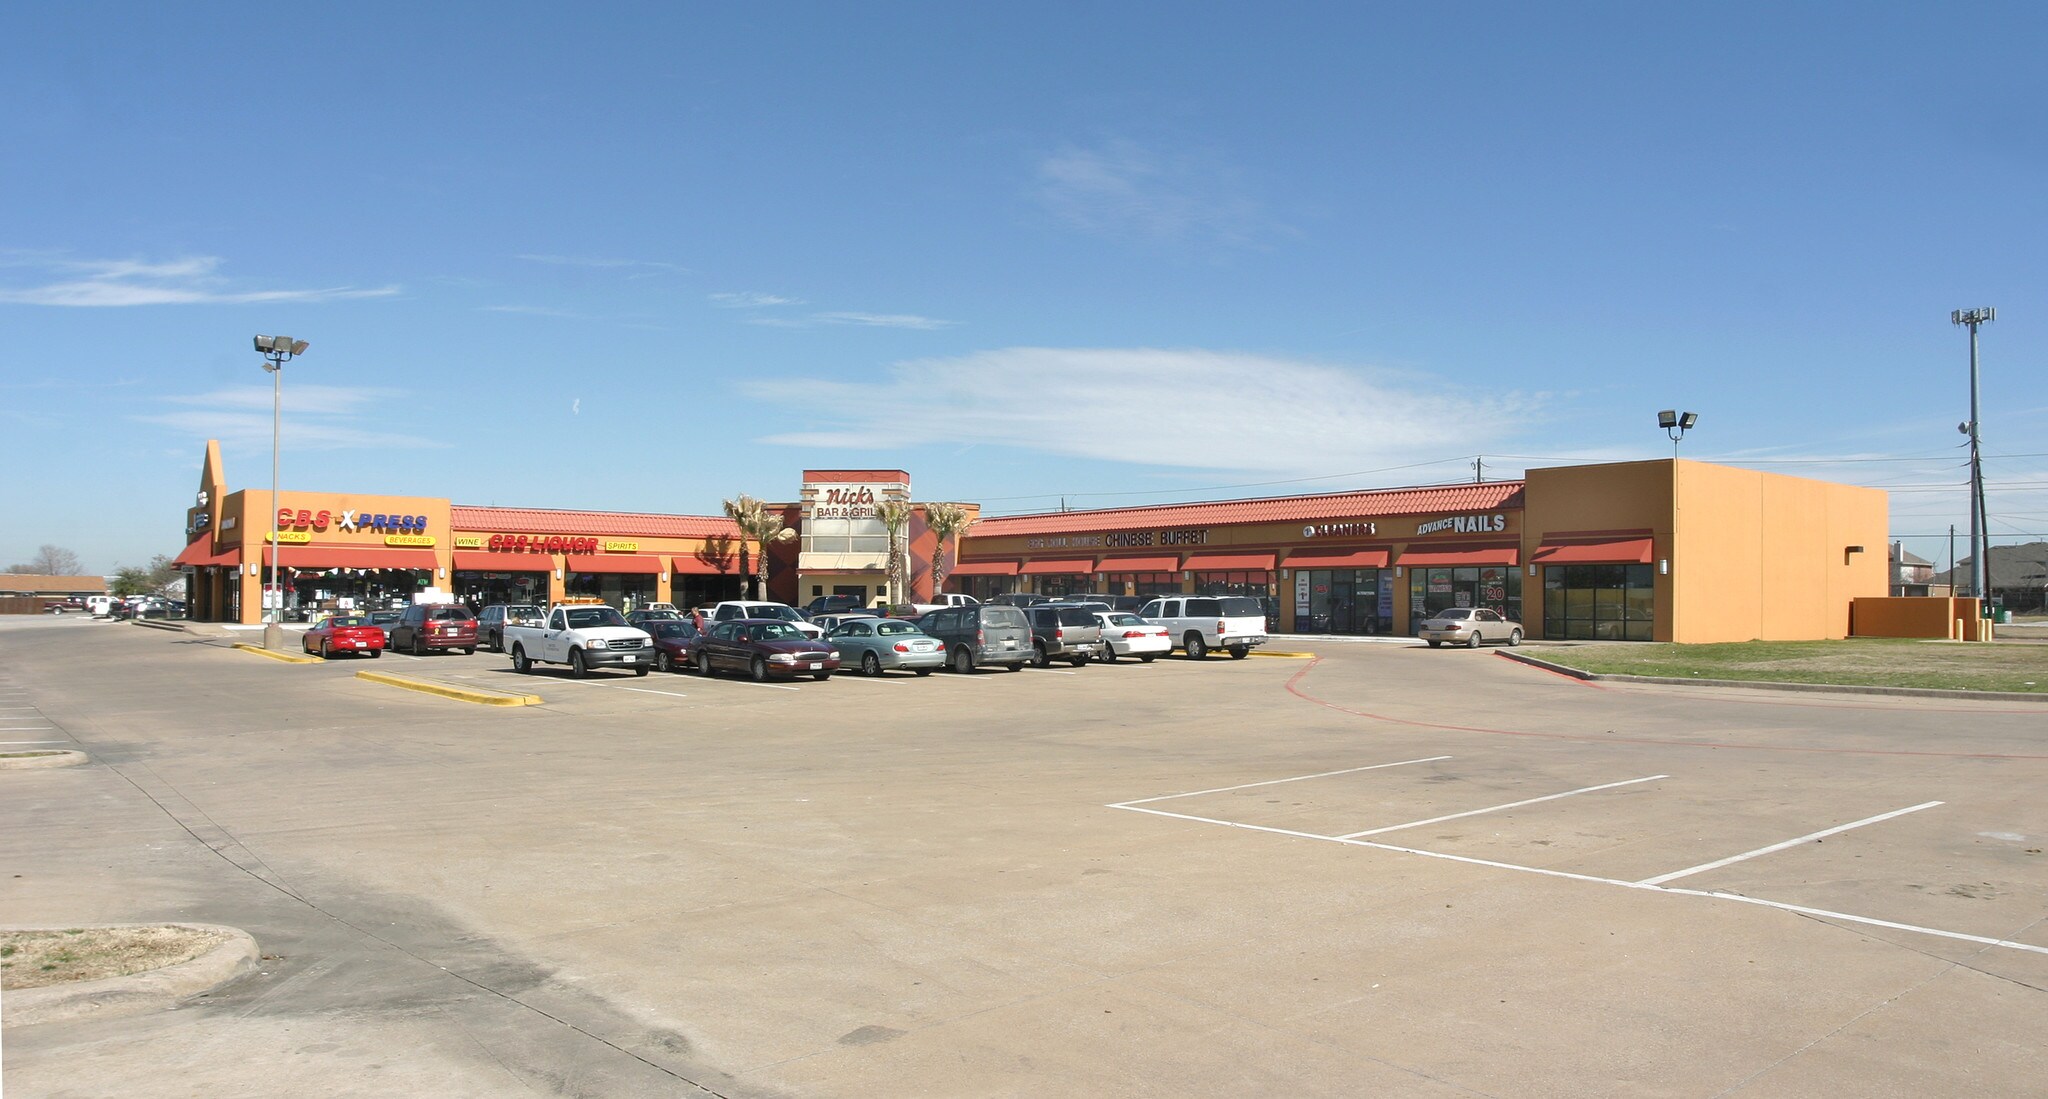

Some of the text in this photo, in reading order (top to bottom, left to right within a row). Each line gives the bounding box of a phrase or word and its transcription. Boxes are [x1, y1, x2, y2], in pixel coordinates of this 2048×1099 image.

[826, 486, 874, 505] Nick's
[277, 508, 331, 528] CBS
[817, 508, 879, 517] BAR & GRIL
[1314, 522, 1376, 538] CLEANERS
[1416, 514, 1505, 536] ADVANCE NAILS
[273, 532, 306, 541] NACKS
[388, 536, 431, 544] BEVERAGES
[457, 538, 480, 546] WINE
[489, 534, 599, 551] CBS LIQUOR
[1105, 531, 1155, 547] CHINESE
[1160, 529, 1209, 545] BUFFET
[607, 542, 637, 550] SPIRITS
[1487, 587, 1504, 600] 20
